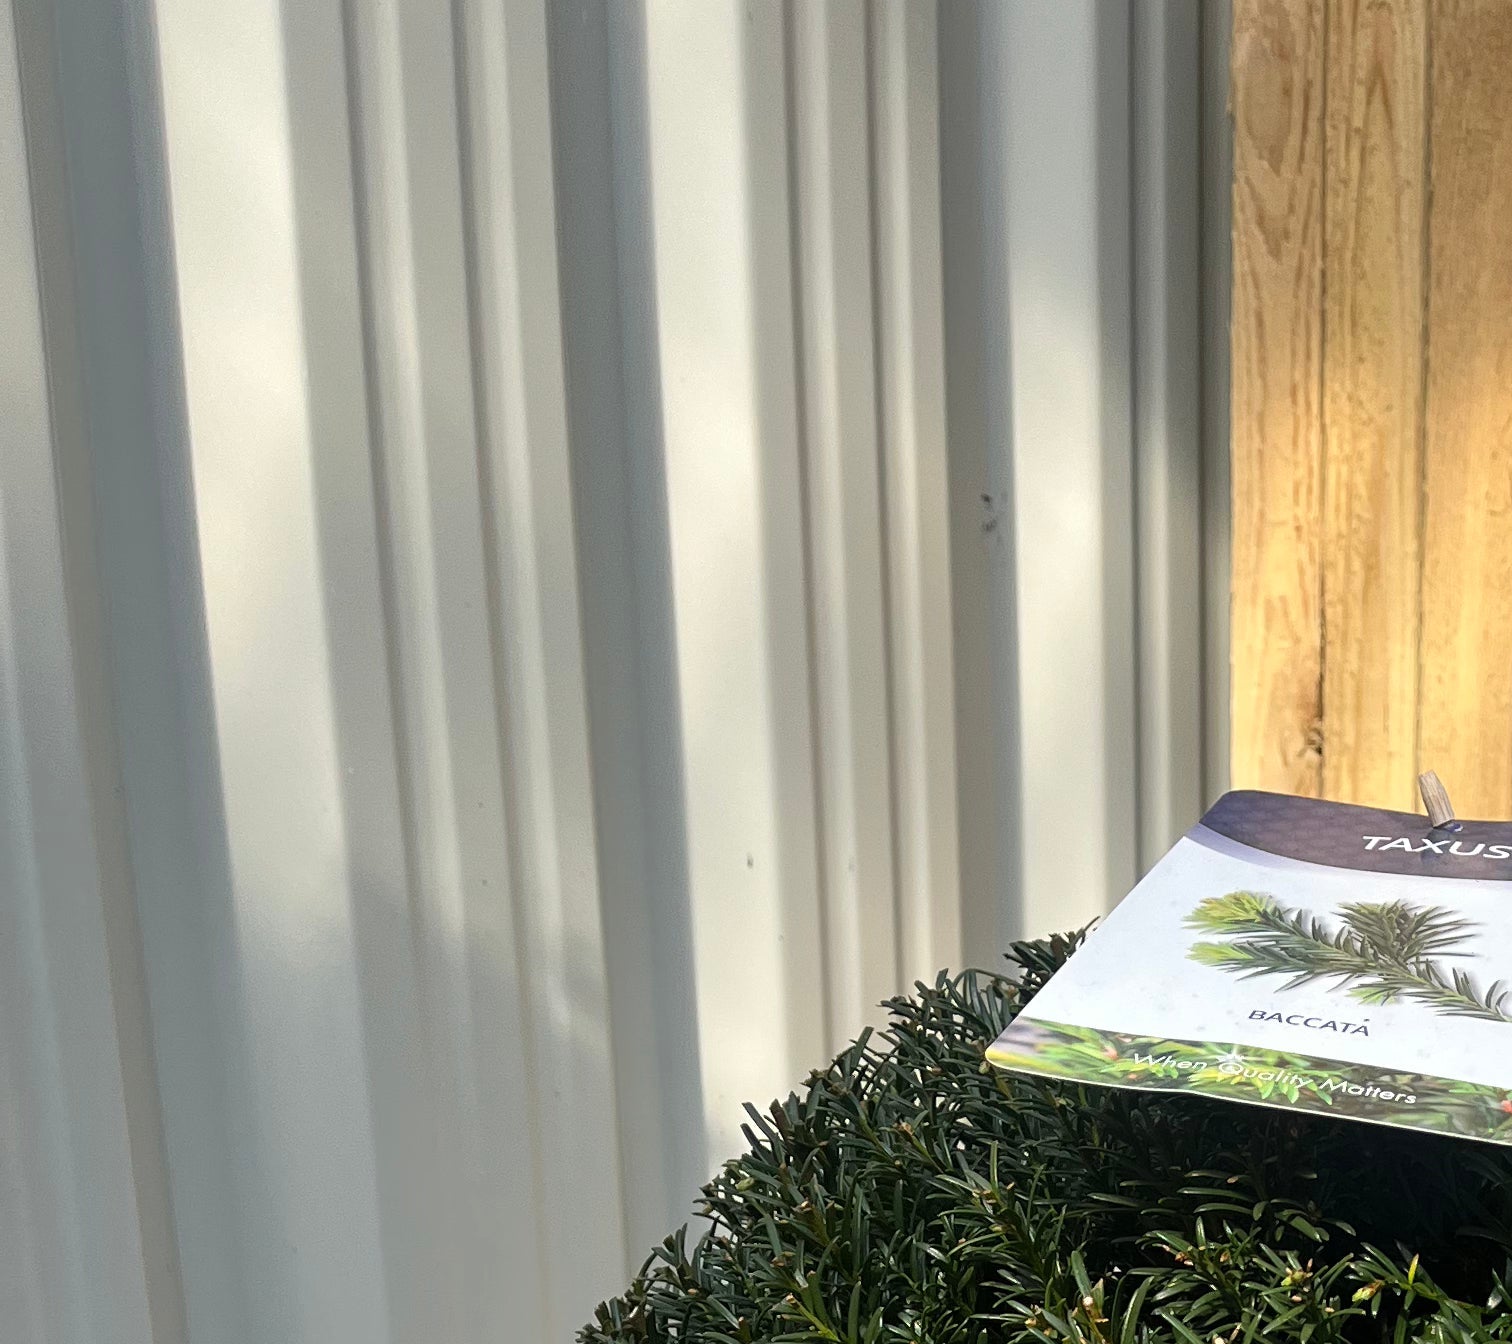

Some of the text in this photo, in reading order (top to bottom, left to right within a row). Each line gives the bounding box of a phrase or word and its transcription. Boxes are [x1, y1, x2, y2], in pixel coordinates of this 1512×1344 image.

[1248, 1010, 1370, 1037] BACCATA
[1133, 1053, 1418, 1105] When Quality Matters
